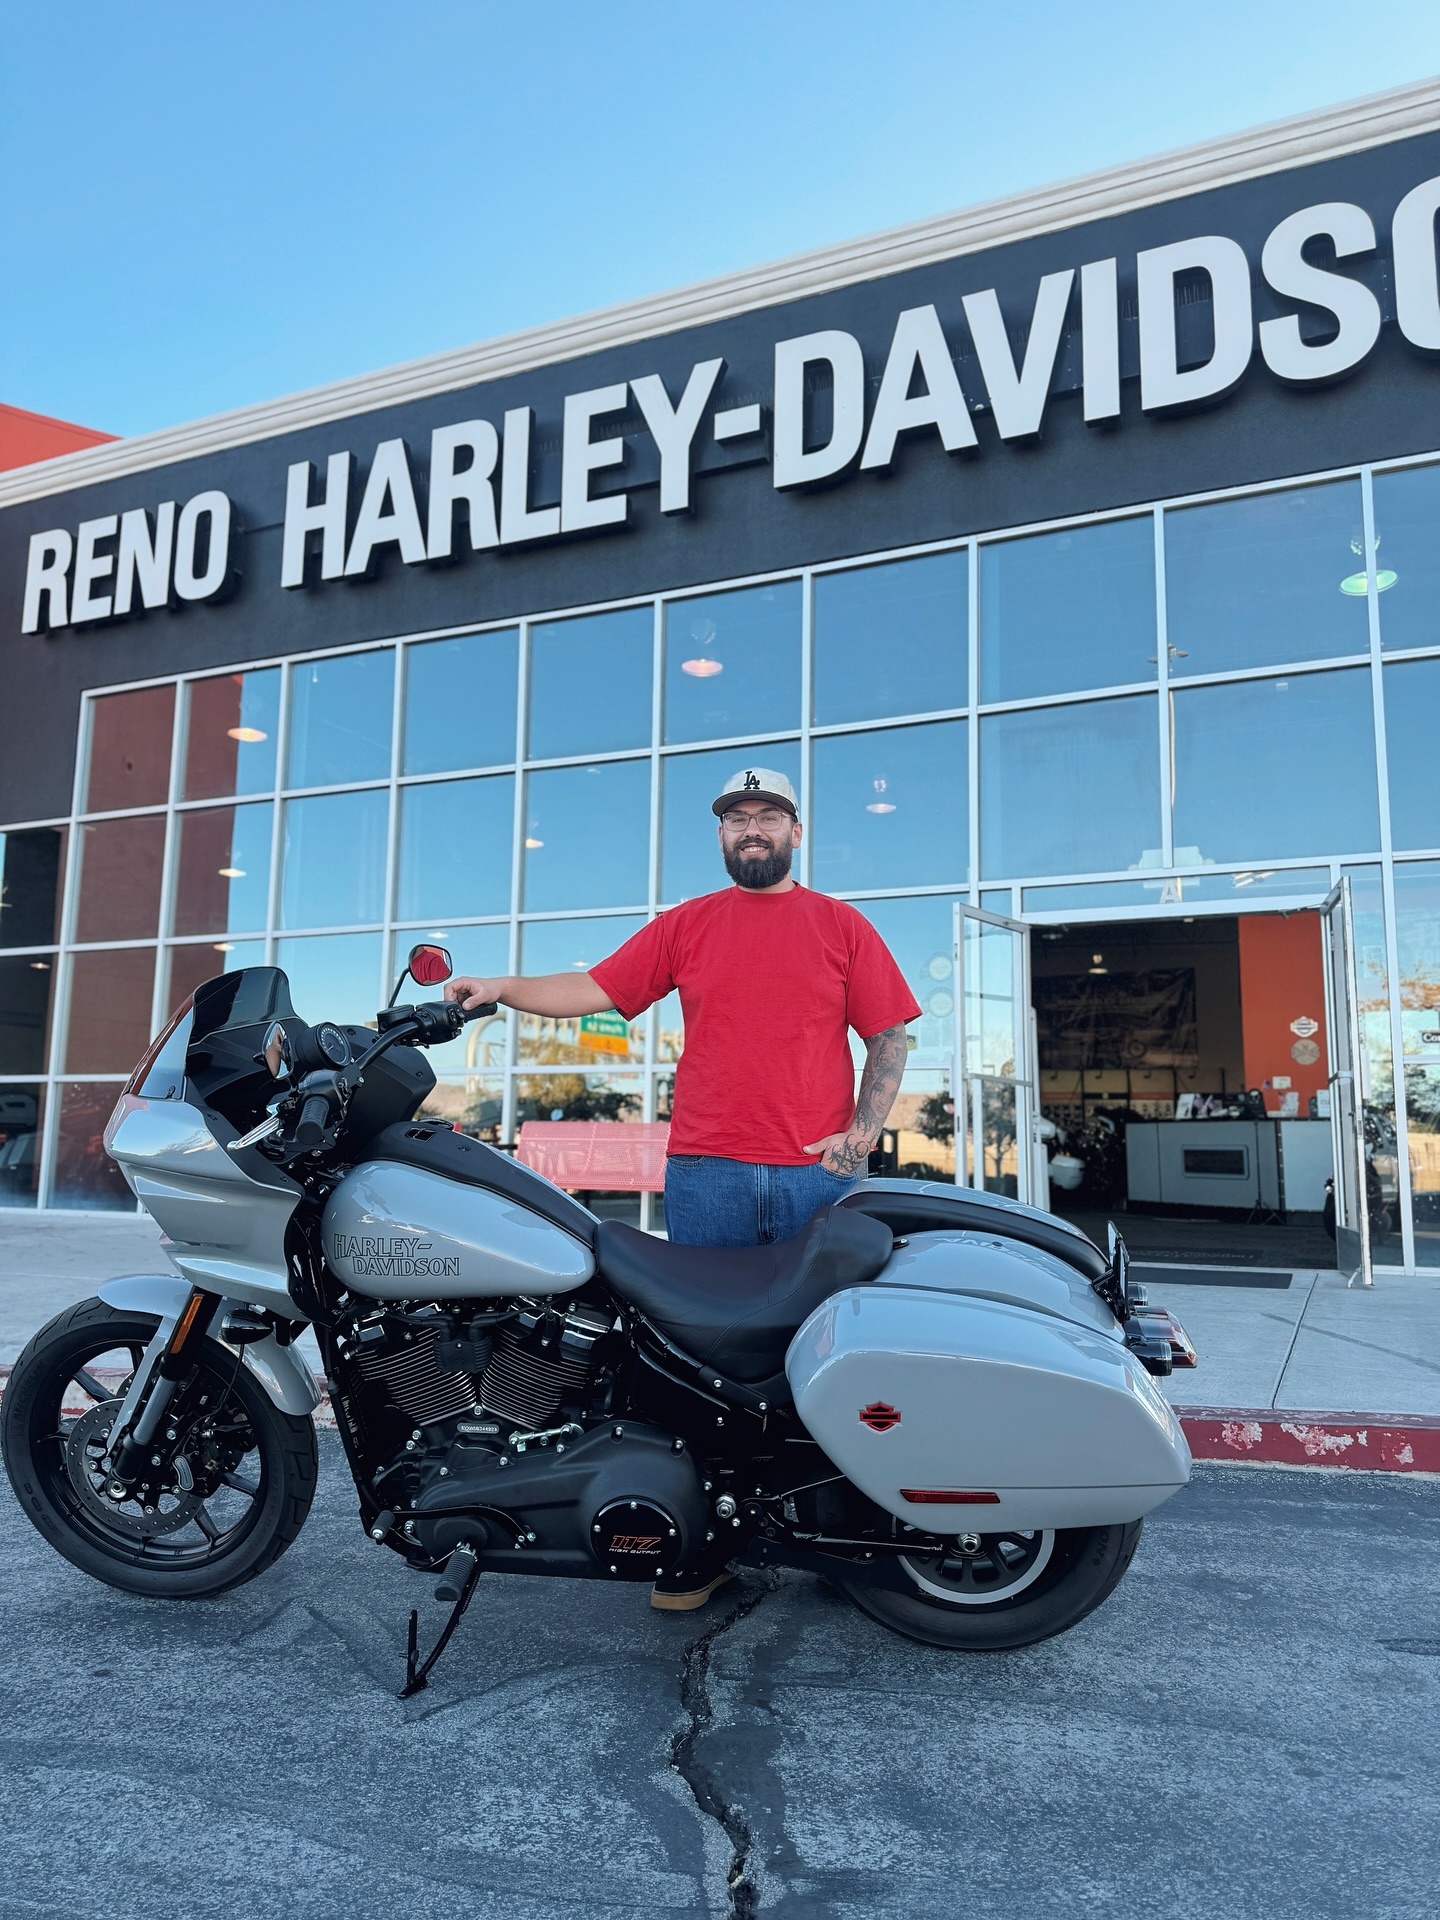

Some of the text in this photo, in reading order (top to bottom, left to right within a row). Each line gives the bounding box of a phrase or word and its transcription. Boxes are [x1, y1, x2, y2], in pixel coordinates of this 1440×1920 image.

[21, 489, 232, 634] RENO
[743, 770, 761, 790] LA
[333, 1233, 433, 1260] HARLEY-
[352, 1256, 461, 1277] DAVIDSON
[610, 1534, 662, 1550] 117
